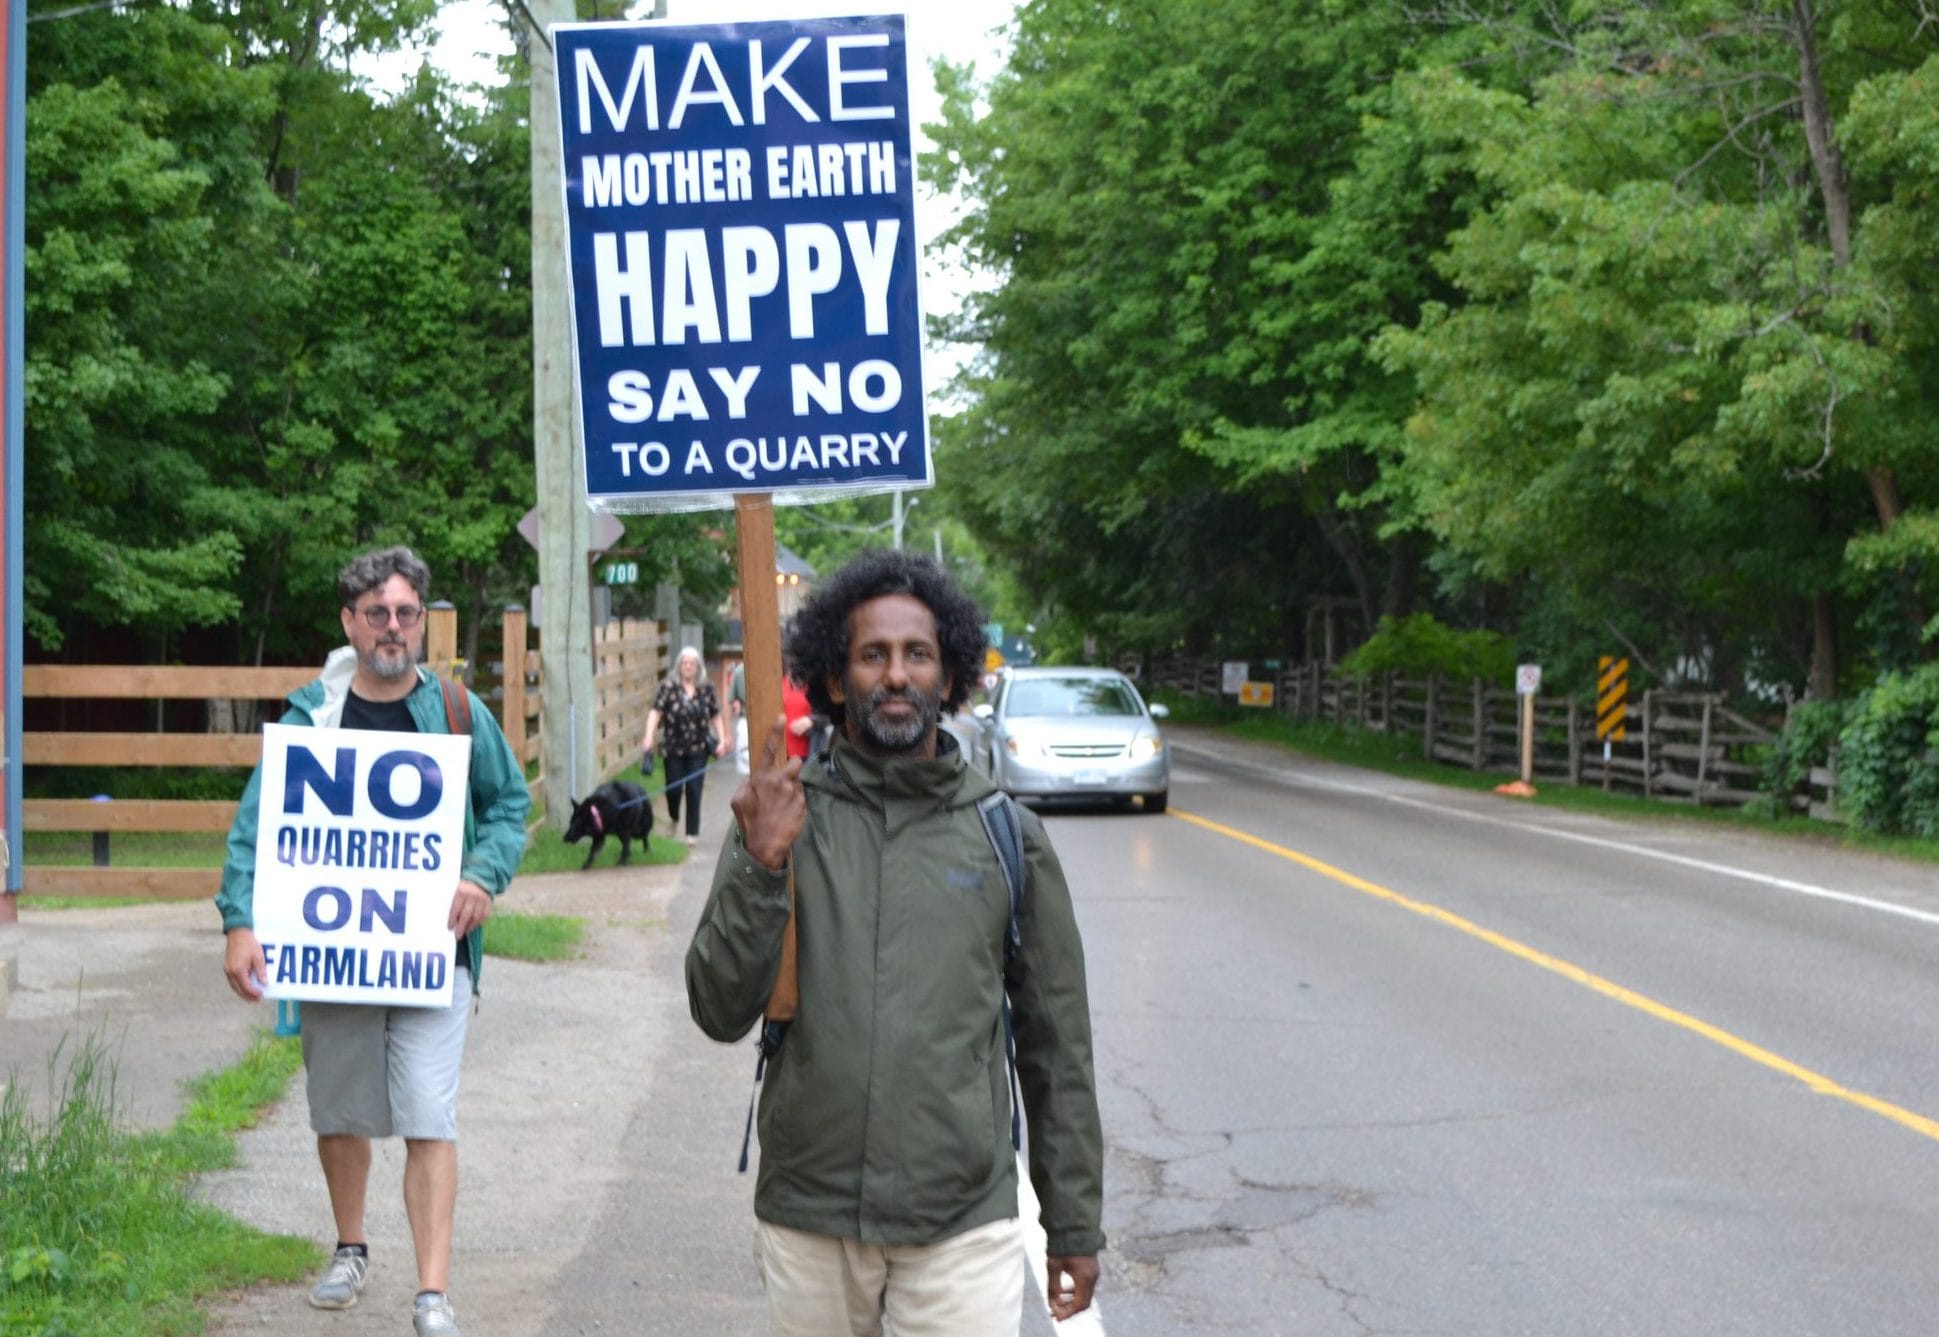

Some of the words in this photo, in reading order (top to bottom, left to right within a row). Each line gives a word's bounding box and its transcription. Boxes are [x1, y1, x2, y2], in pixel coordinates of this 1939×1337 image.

[574, 33, 896, 134] MAKE
[581, 148, 753, 208] MOTHER
[766, 140, 897, 200] EARTH
[593, 218, 901, 348] HAPPY
[607, 365, 762, 424] SAY
[790, 359, 903, 416] NO
[611, 441, 671, 477] TO
[684, 440, 714, 475] A
[725, 430, 908, 480] QUARRY
[606, 563, 638, 584] 700
[283, 745, 444, 821] NO
[277, 825, 442, 872] QUARRIES
[302, 885, 408, 935] ON
